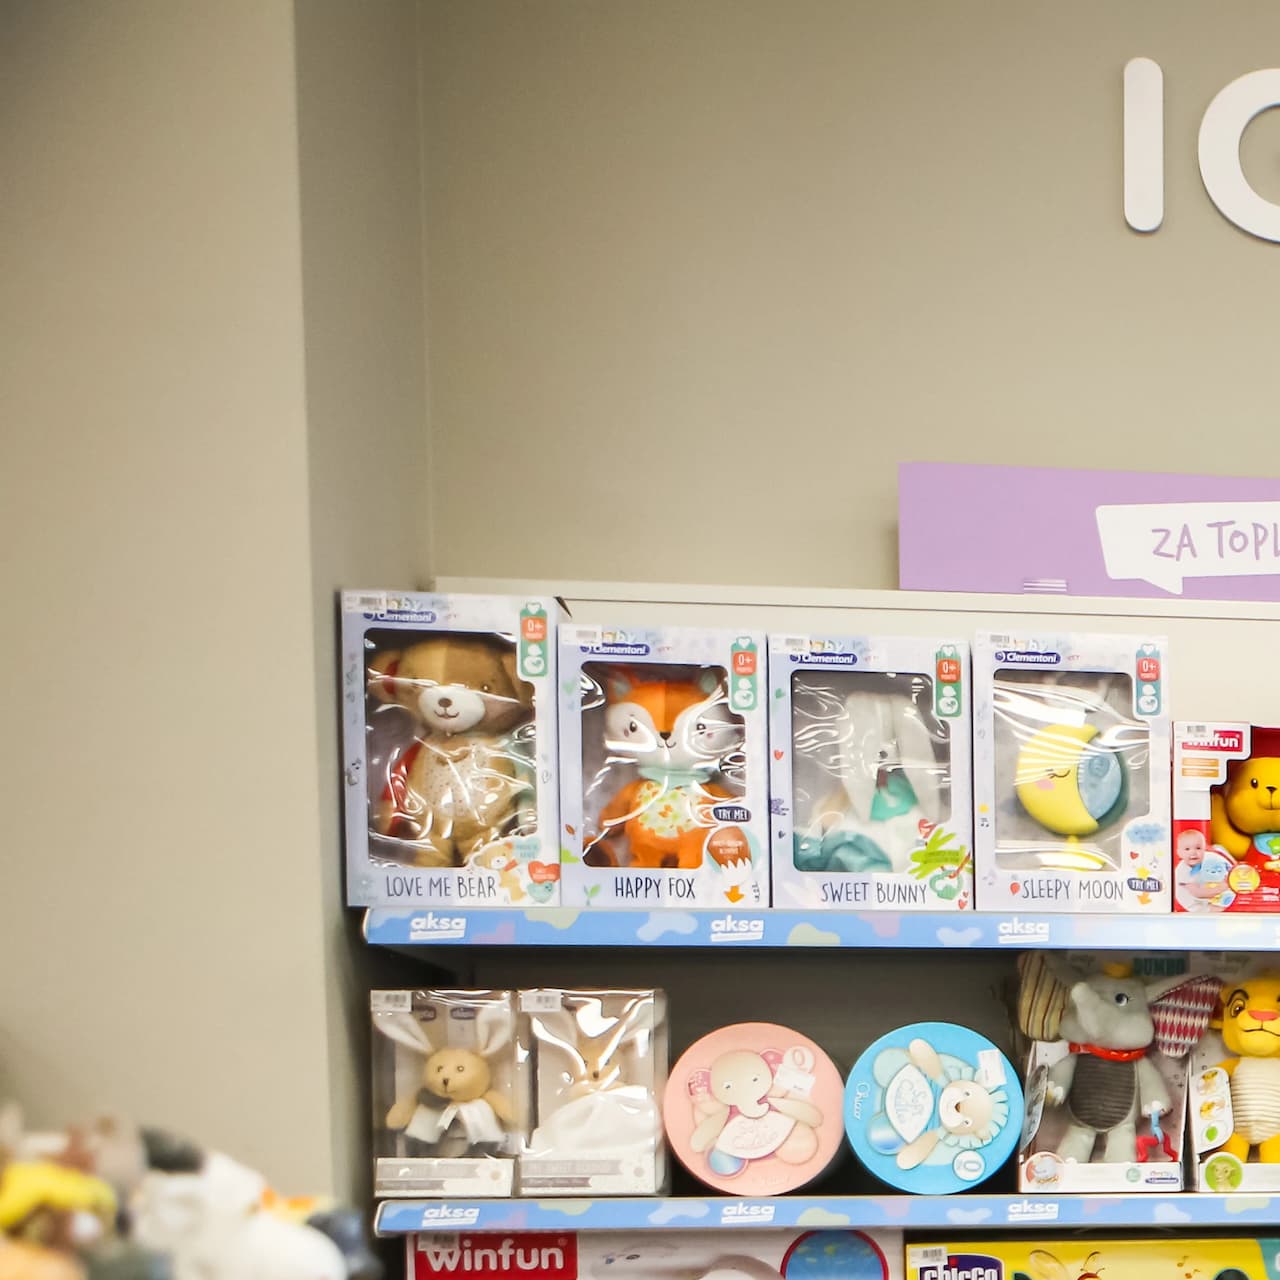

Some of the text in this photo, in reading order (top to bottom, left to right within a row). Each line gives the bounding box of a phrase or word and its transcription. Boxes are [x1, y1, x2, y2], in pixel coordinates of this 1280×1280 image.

[1151, 524, 1195, 561] ZA
[1006, 652, 1056, 663] Clementoni
[386, 875, 496, 898] LOVE ME BEAR
[614, 877, 696, 899] HAPPY FOX
[821, 882, 927, 904] SWEET BUNNY
[1022, 879, 1124, 901] SLEEPY MOON
[410, 915, 466, 934] aksa
[422, 1206, 479, 1222] aksa
[425, 1238, 565, 1272] winfun
